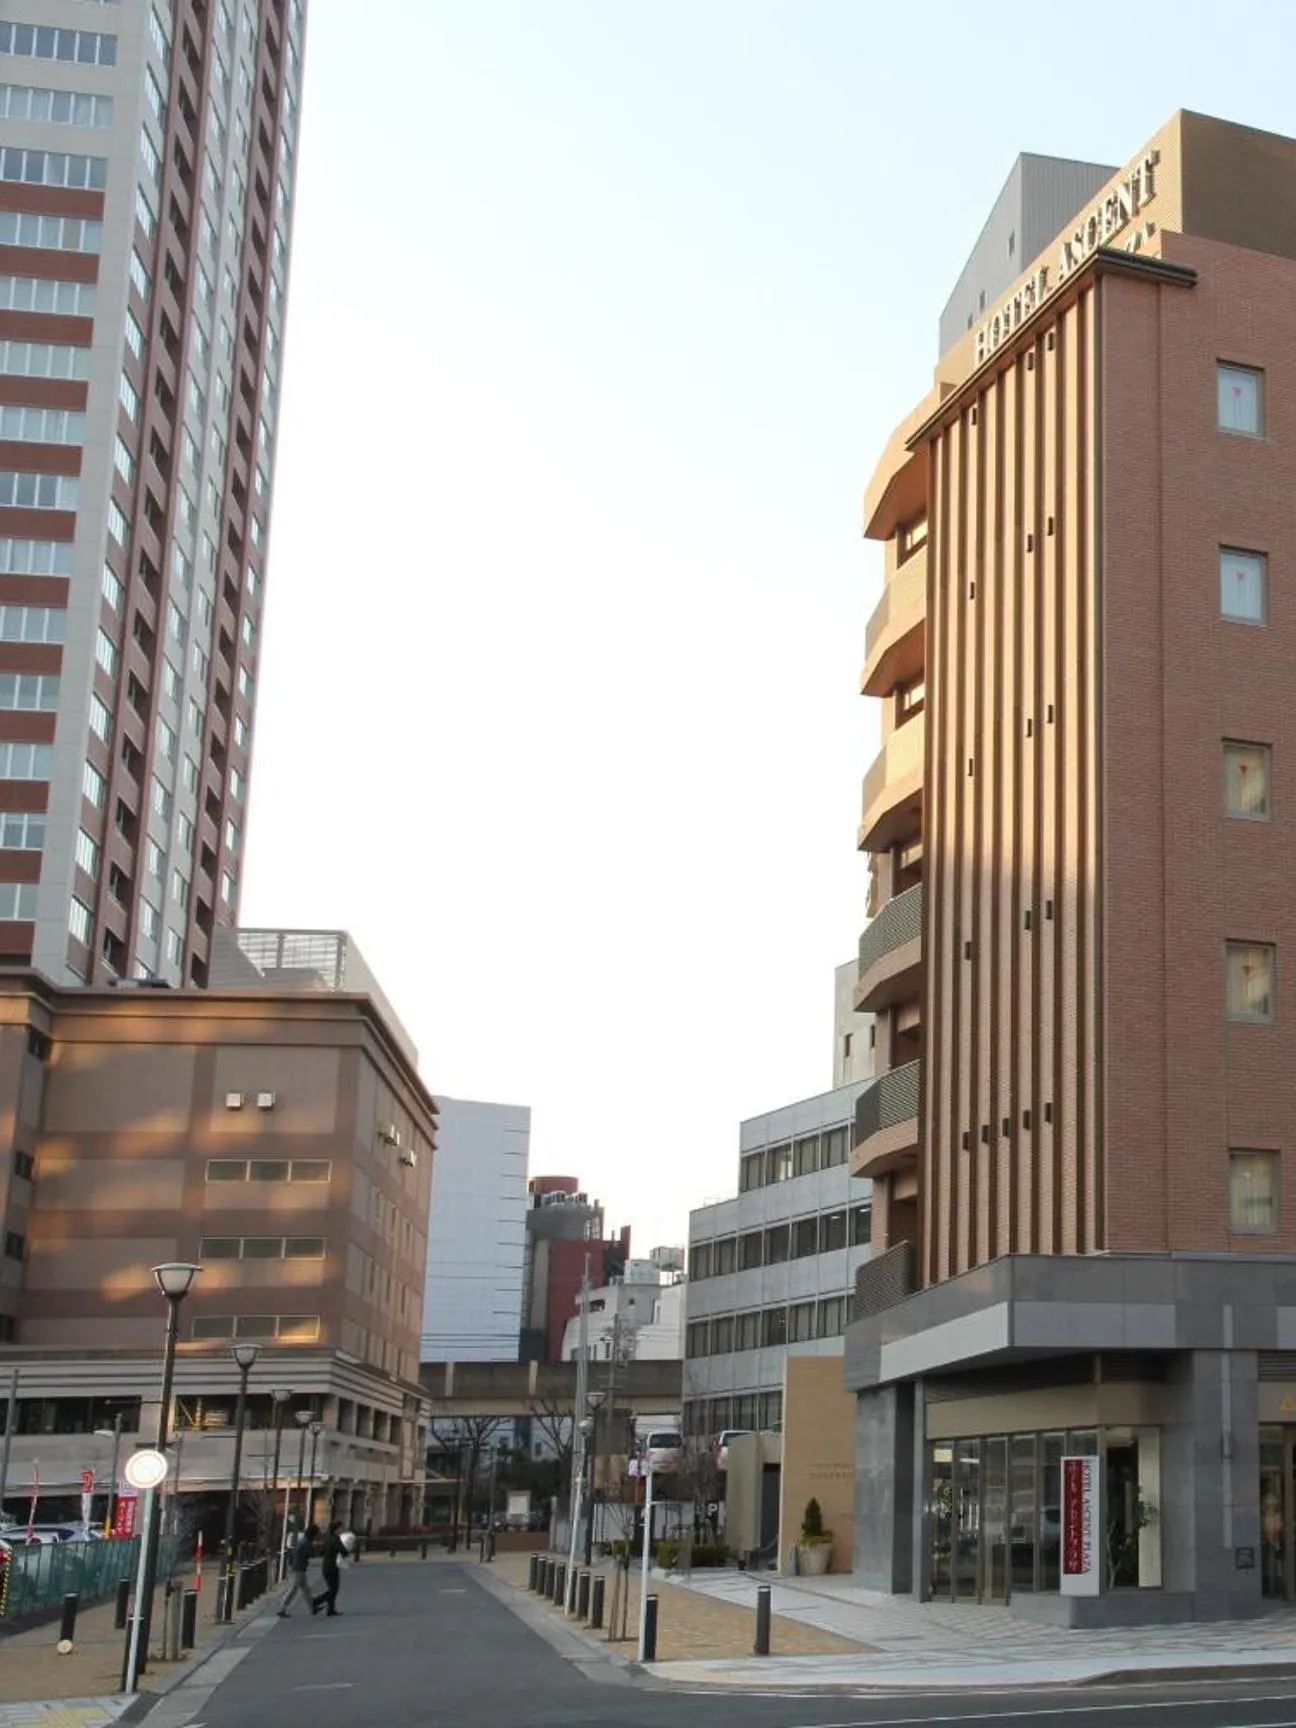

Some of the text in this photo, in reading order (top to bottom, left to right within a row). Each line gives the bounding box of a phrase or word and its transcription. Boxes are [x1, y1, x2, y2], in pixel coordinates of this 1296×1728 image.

[1058, 148, 1161, 284] ASCENT
[1082, 1459, 1092, 1574] HOTEL ASCENT PLAZA
